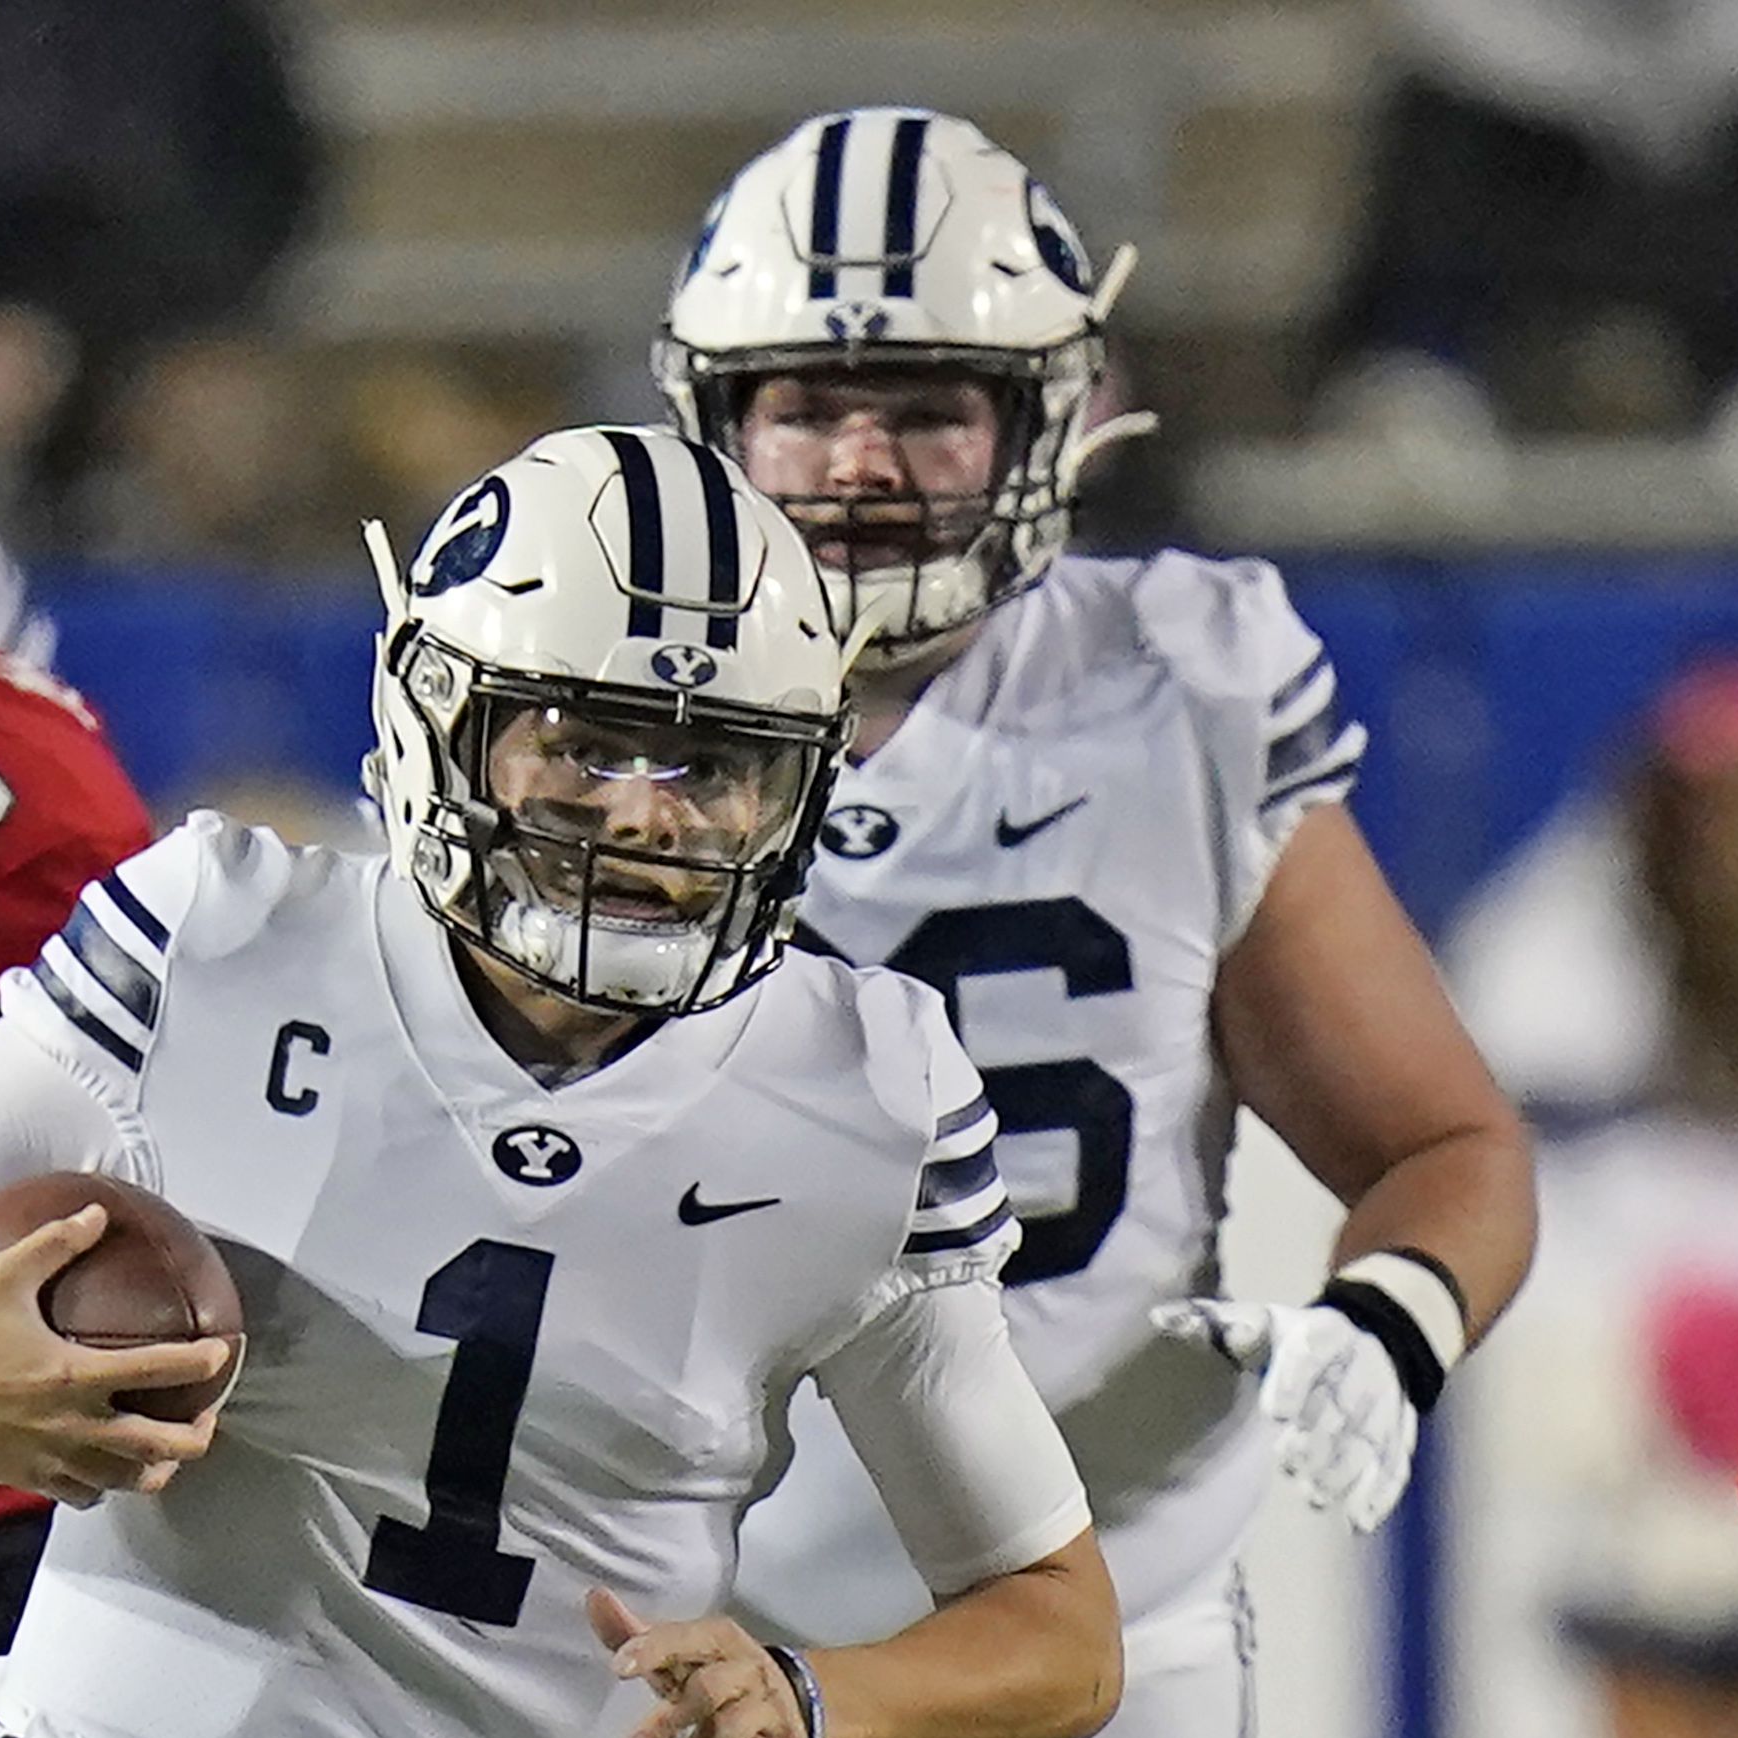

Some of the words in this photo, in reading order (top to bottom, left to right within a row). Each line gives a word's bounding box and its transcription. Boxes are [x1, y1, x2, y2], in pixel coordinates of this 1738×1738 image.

[662, 648, 710, 685] Y
[826, 808, 889, 854] Y
[265, 1019, 331, 1117] C
[506, 1130, 571, 1178] Y
[362, 1237, 557, 1628] 1
